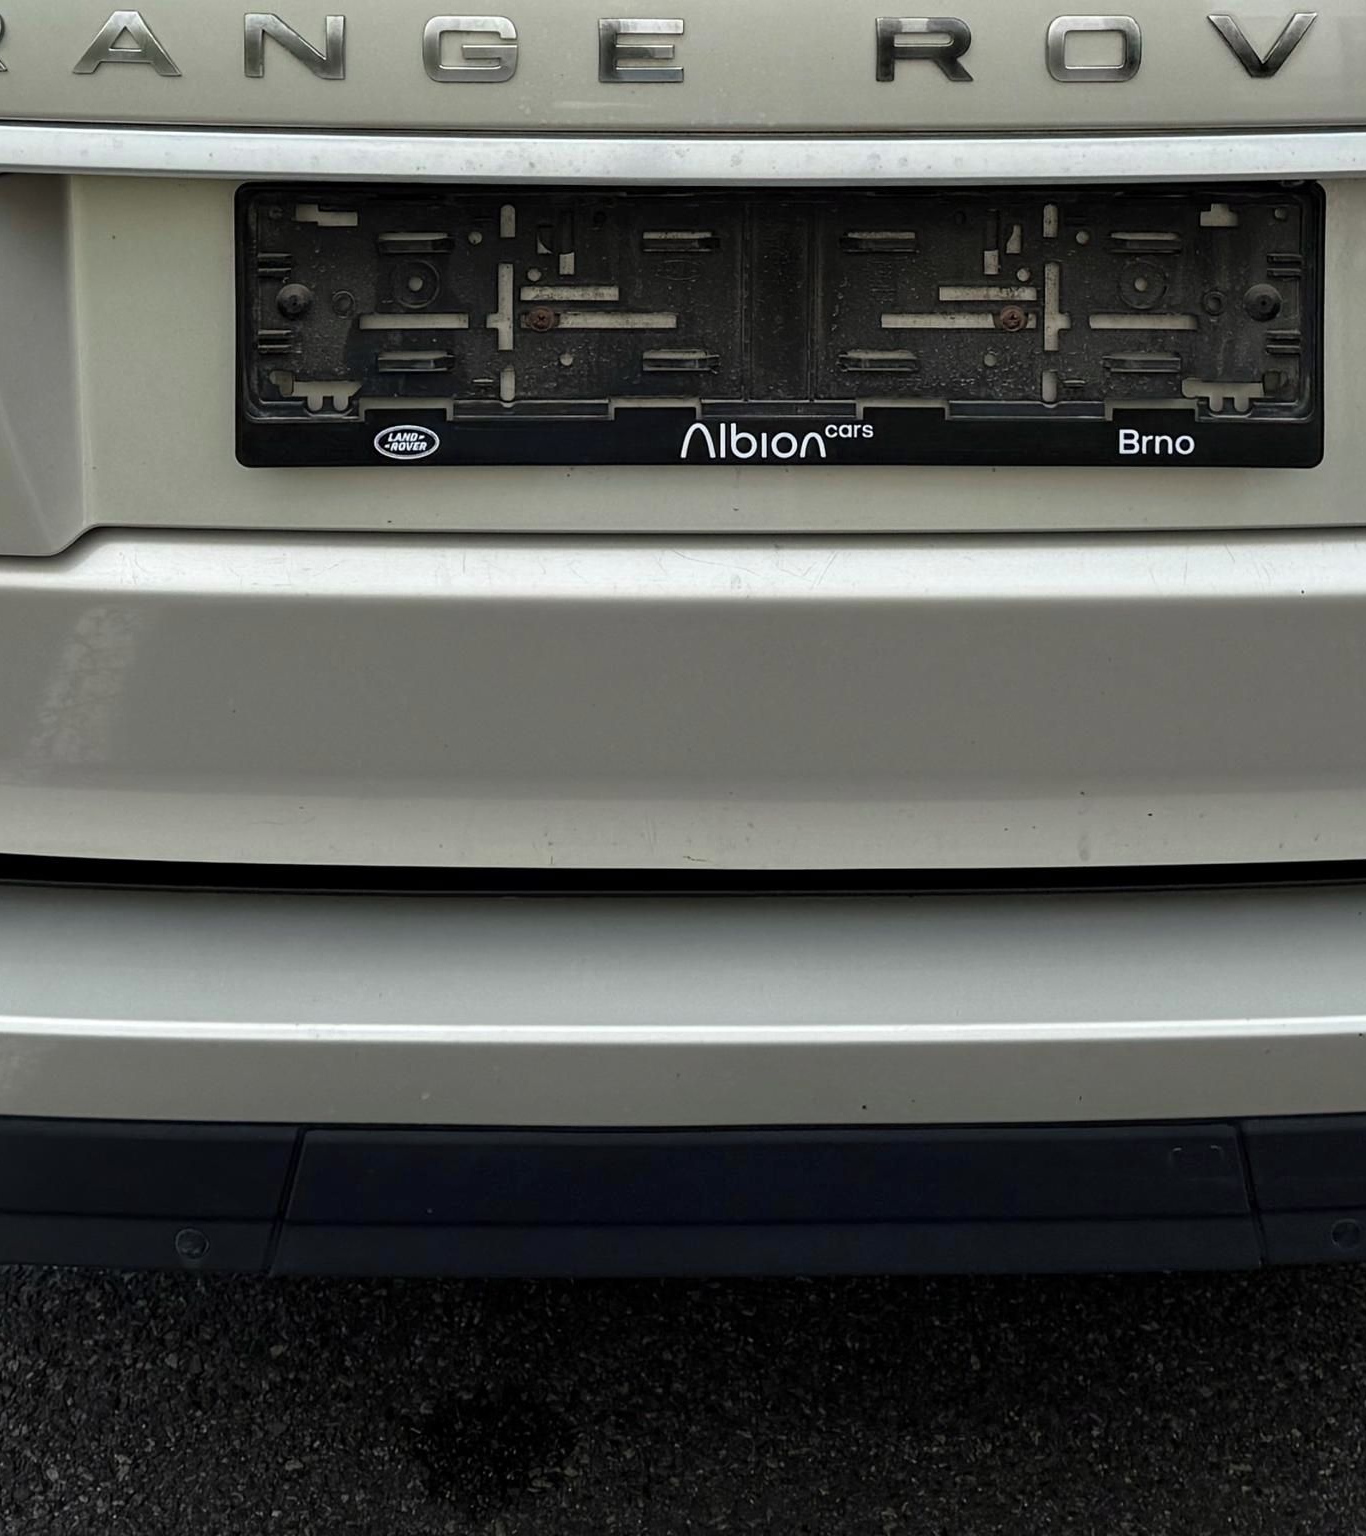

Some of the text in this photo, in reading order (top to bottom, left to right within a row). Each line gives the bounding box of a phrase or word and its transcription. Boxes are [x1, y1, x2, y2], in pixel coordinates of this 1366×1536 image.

[388, 432, 418, 442] LAND
[680, 422, 1196, 459] Albion cars Brno
[390, 442, 427, 451] ROVER
